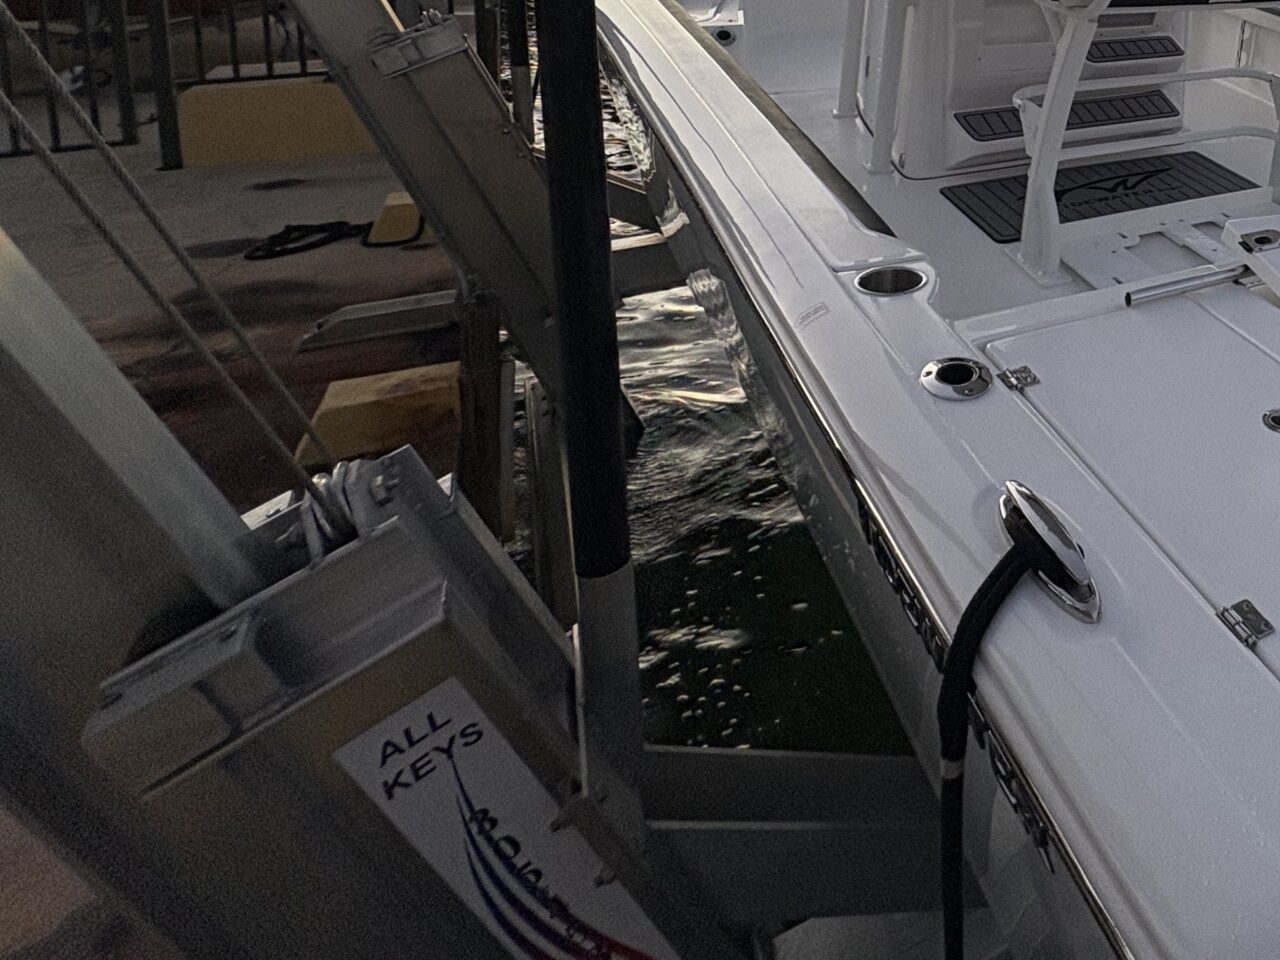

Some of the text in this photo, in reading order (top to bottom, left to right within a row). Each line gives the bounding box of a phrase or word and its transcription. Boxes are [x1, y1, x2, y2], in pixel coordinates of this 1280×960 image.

[1062, 189, 1153, 209] IDEWATER
[378, 711, 453, 769] ALL
[382, 722, 484, 801] KEYS
